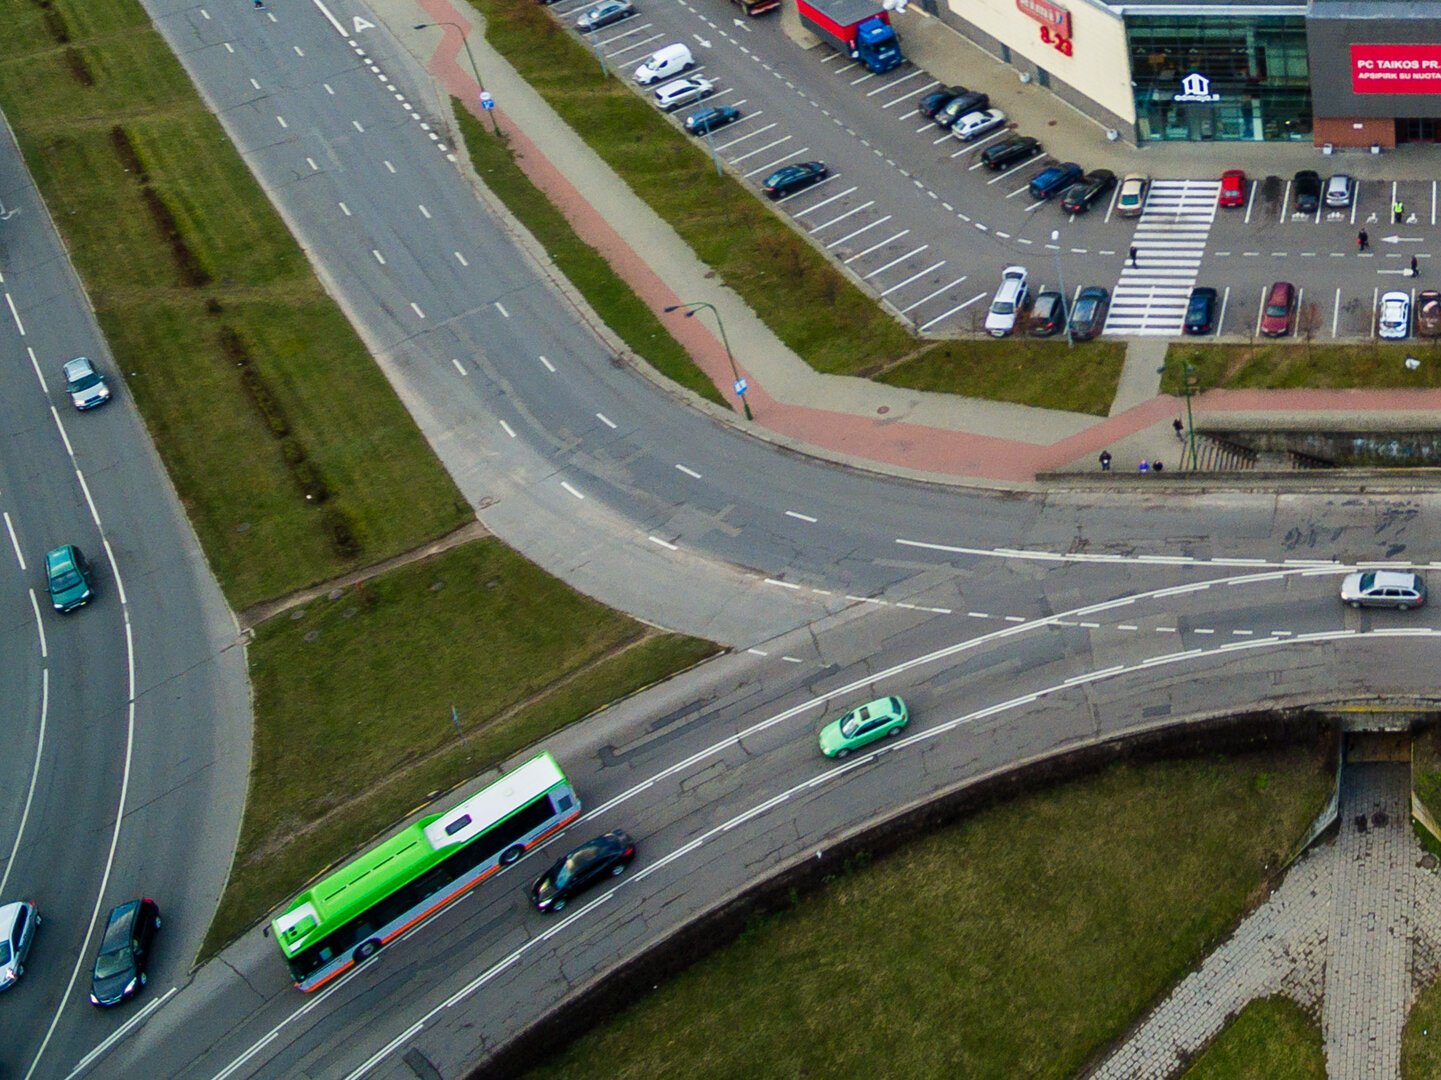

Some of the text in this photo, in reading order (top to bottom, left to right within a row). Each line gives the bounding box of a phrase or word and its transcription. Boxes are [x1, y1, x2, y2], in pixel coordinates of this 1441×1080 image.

[1357, 60, 1374, 69] PC
[1376, 60, 1419, 69] TAIKOS
[1422, 60, 1441, 69] PR.
[1358, 72, 1397, 80] APSIPIRK
[1399, 72, 1411, 80] SU
